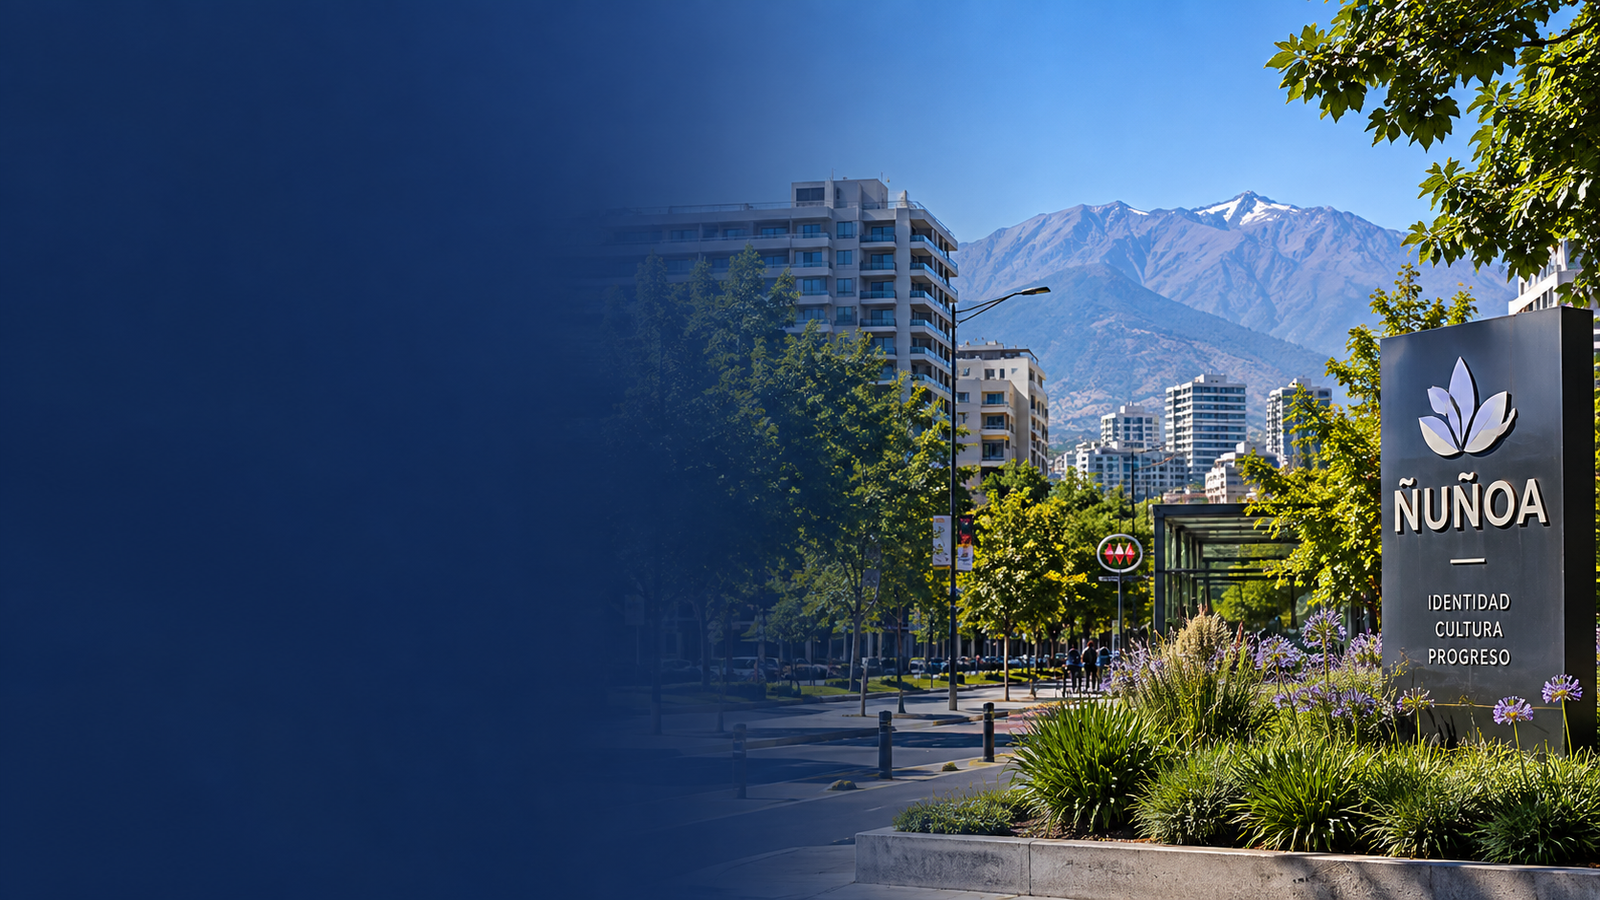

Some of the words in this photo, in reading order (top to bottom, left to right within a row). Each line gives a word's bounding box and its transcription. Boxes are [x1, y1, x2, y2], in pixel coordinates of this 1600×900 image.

[1394, 471, 1548, 532] ÑUÑOA
[1428, 593, 1511, 610] IDENTIDAD
[1435, 621, 1503, 638] CULTURA
[1428, 648, 1511, 665] PROGRESO
